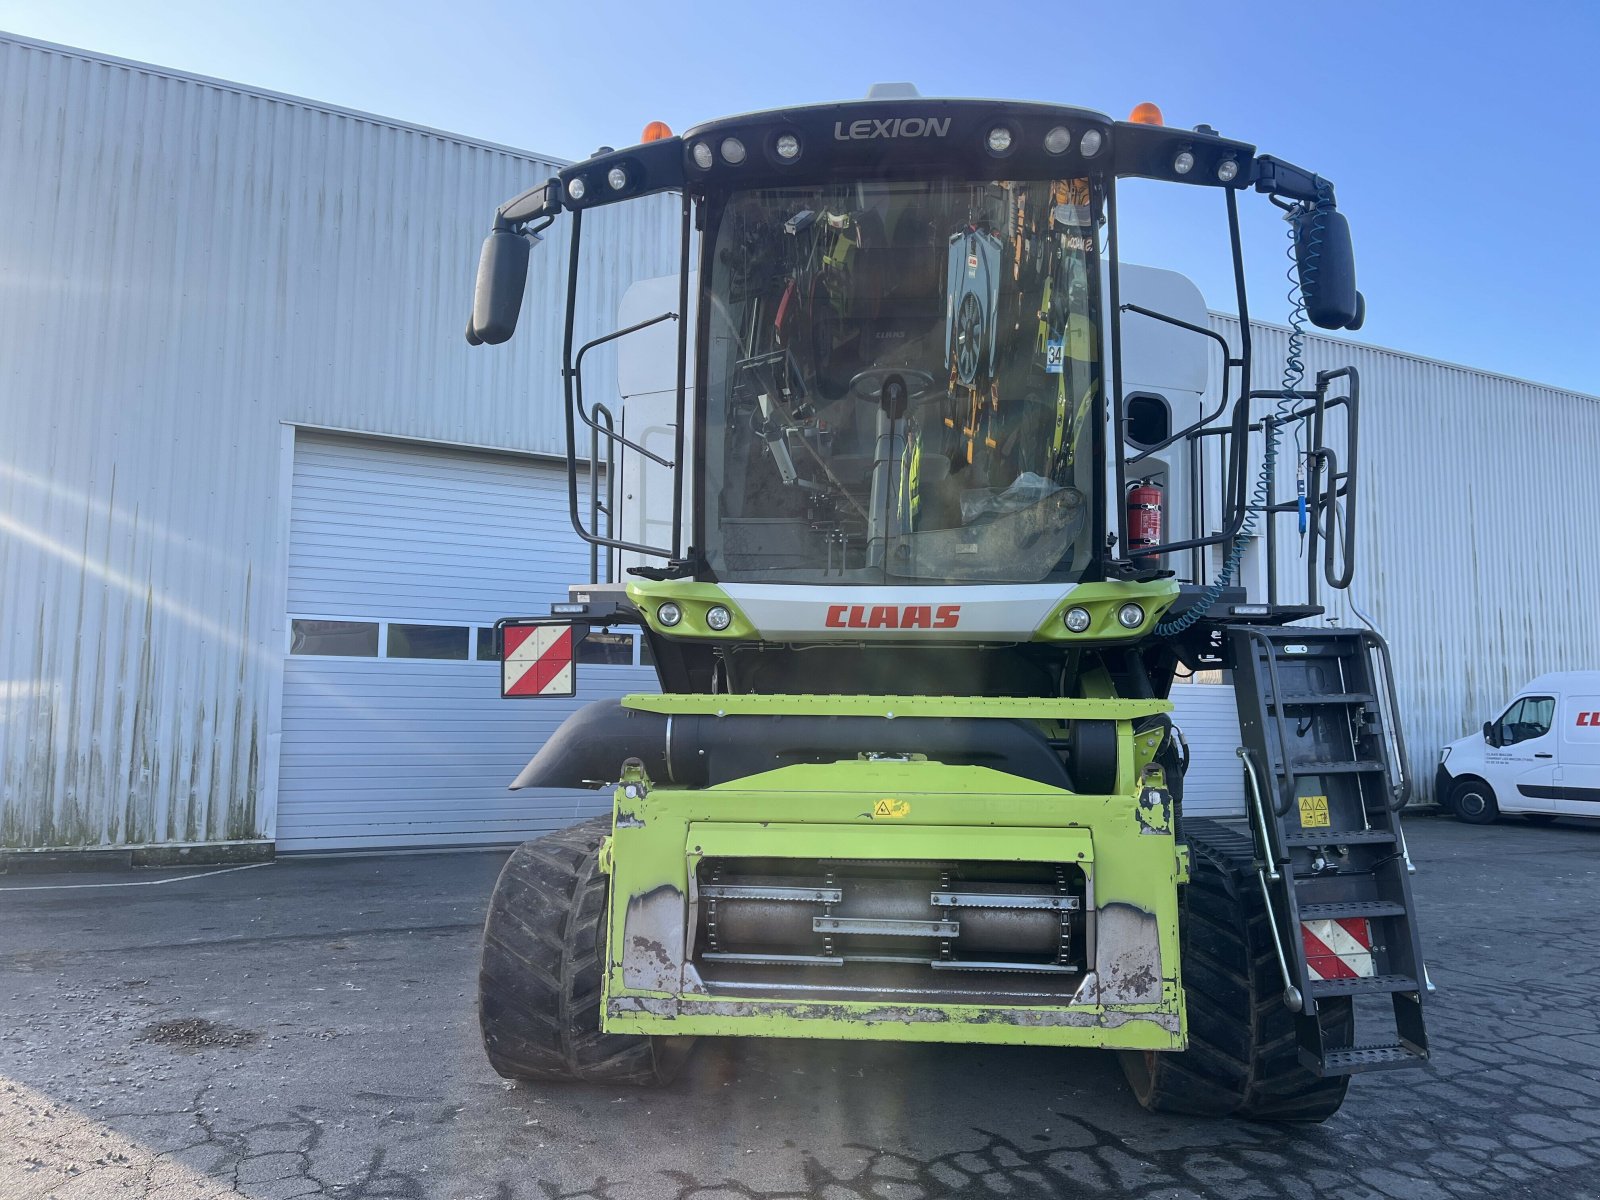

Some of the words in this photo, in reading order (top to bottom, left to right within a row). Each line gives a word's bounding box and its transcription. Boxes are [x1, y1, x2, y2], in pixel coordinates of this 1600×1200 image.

[834, 118, 952, 140] LEXION
[1048, 346, 1062, 364] 34
[825, 605, 961, 628] CLAAS
